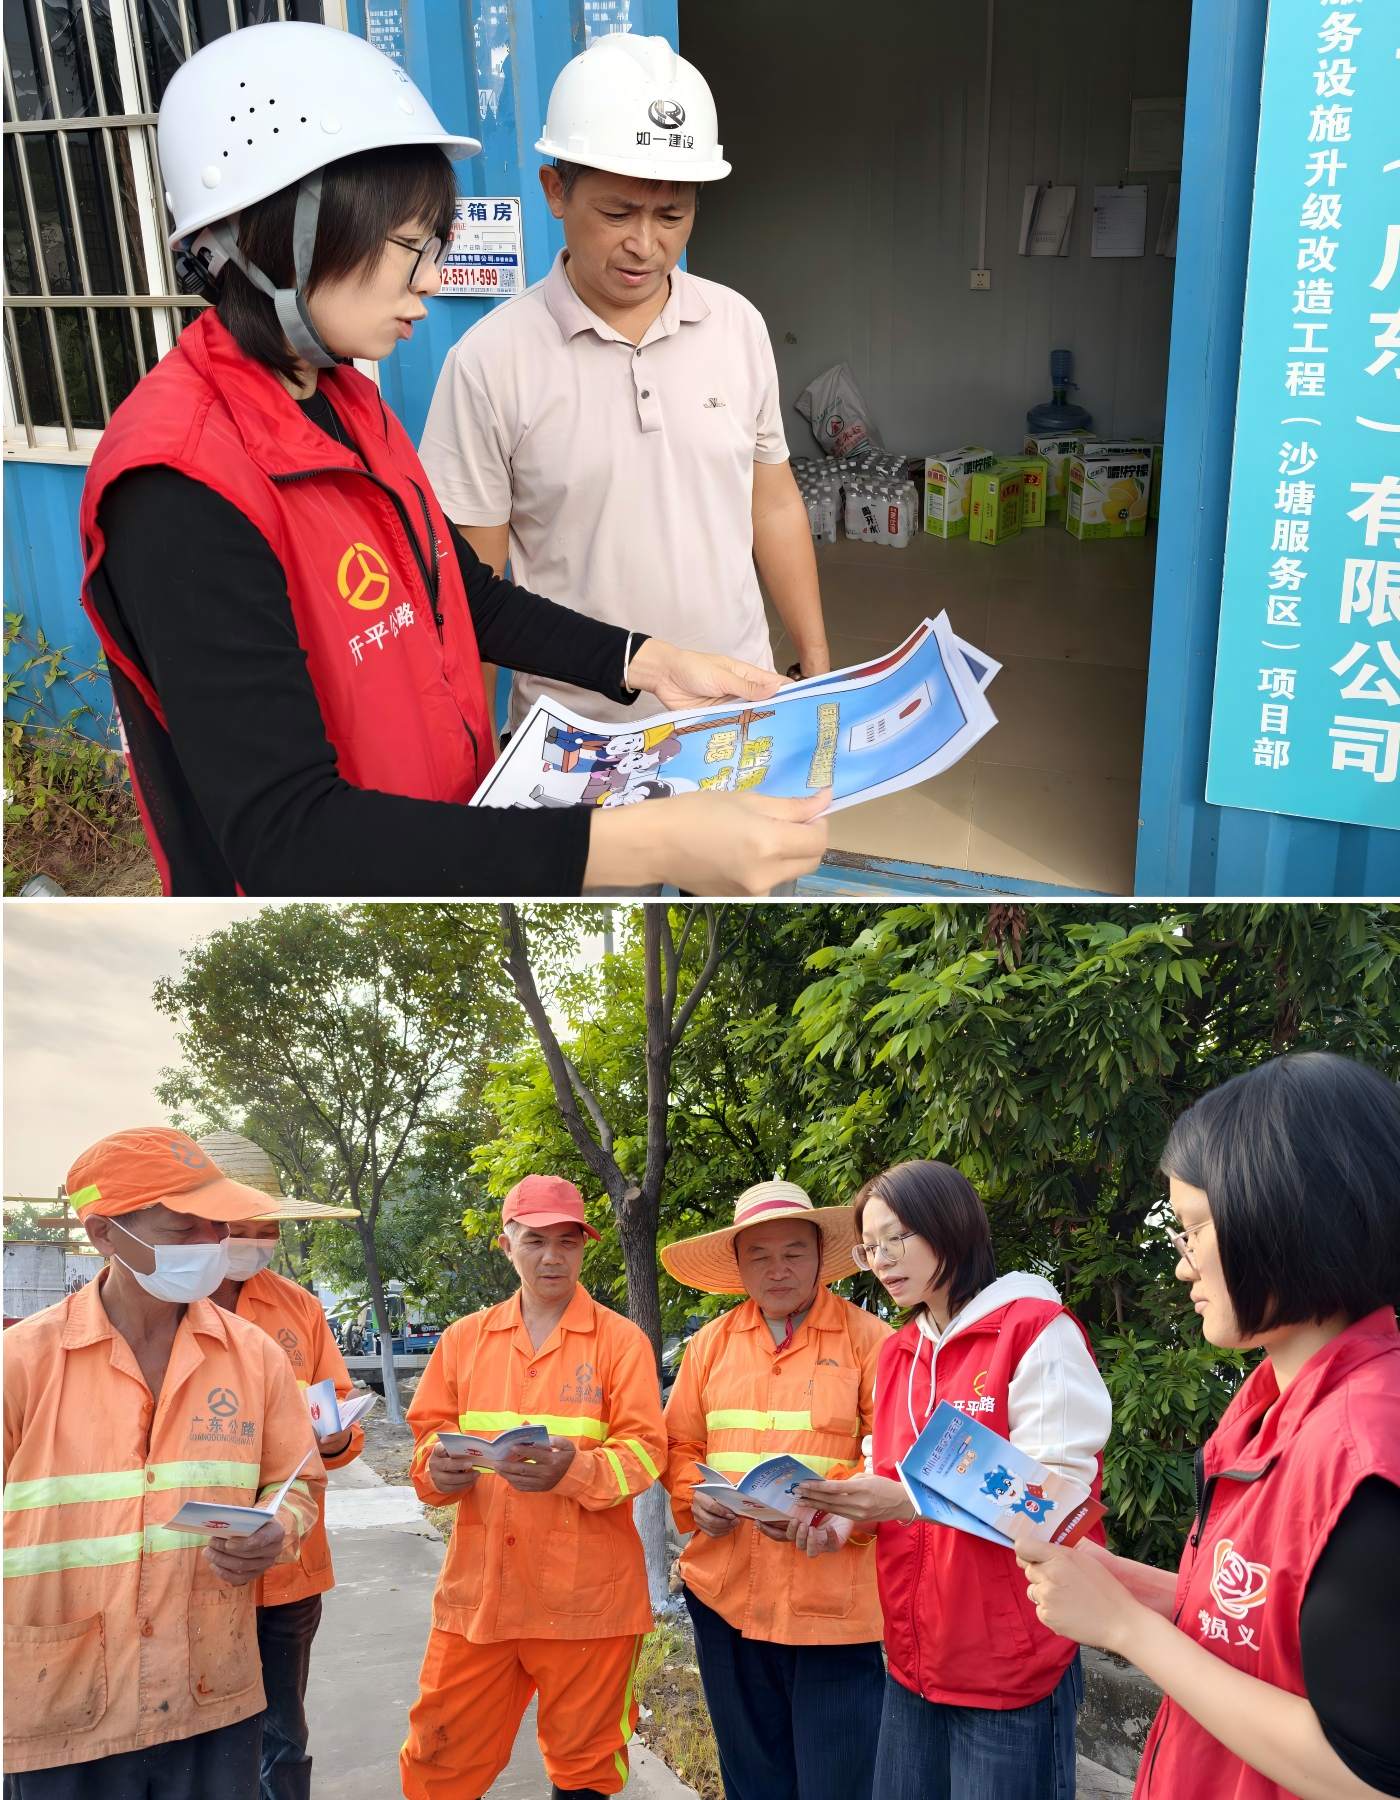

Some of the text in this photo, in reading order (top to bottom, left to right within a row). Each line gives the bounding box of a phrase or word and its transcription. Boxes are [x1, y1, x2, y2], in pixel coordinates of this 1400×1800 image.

[635, 131, 695, 150] 如一建设
[1253, 0, 1363, 770] 务设施升级改造工程(沙塘服务区)项目部
[191, 1416, 255, 1438] 广东公路
